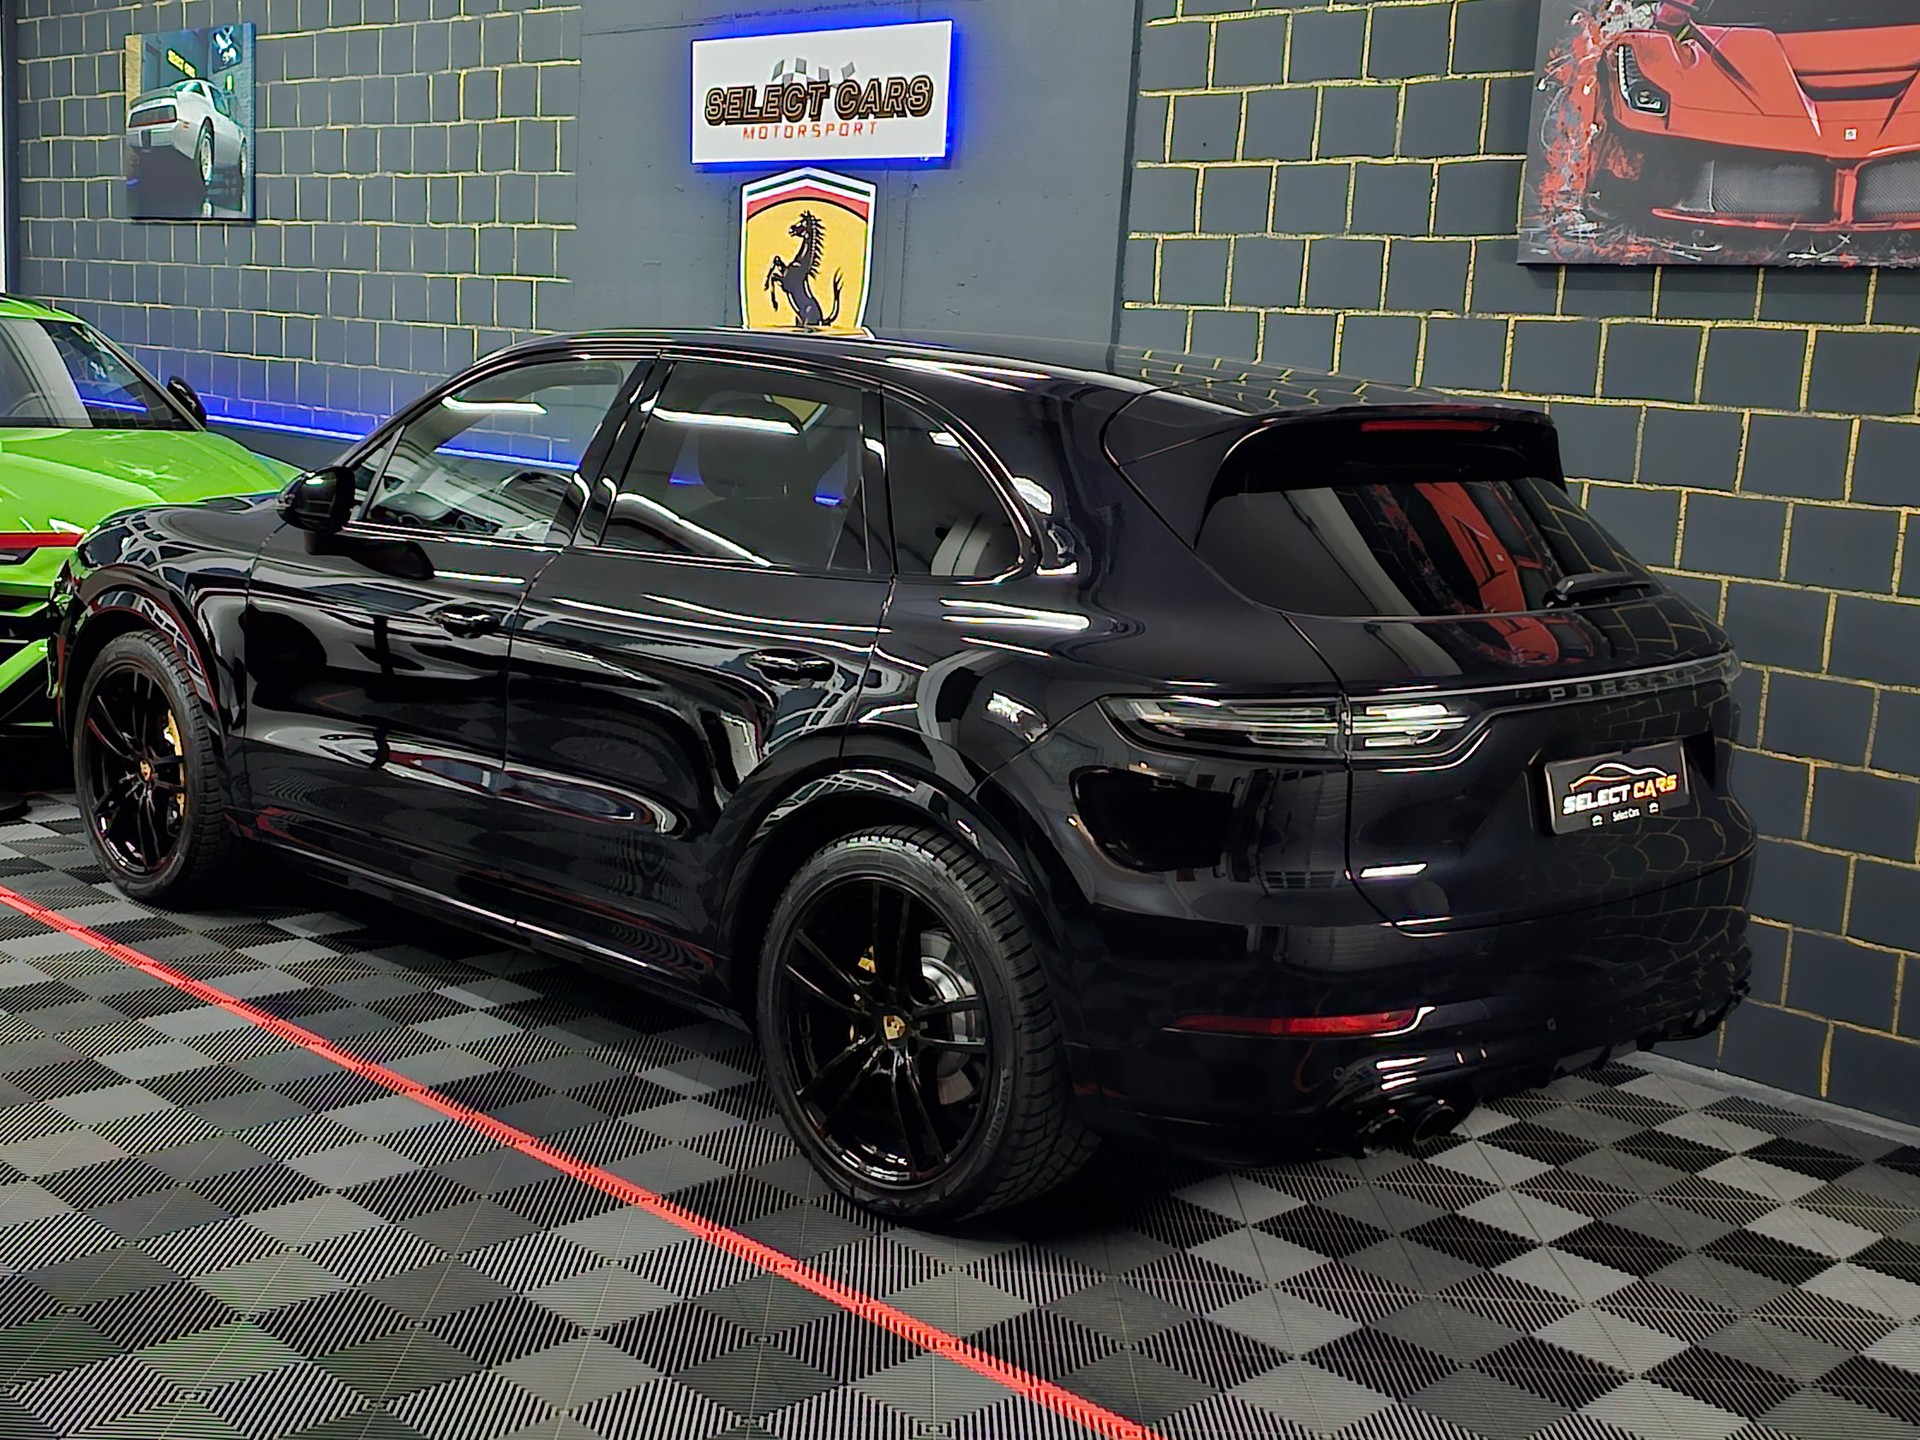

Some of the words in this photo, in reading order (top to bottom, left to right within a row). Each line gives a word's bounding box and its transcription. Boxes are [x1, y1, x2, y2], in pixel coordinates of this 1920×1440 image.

[705, 81, 830, 125] SELECT
[835, 75, 934, 120] CARS
[742, 121, 878, 140] MOTORSPORT
[1563, 784, 1630, 815] SELECT
[1633, 774, 1677, 799] CARS
